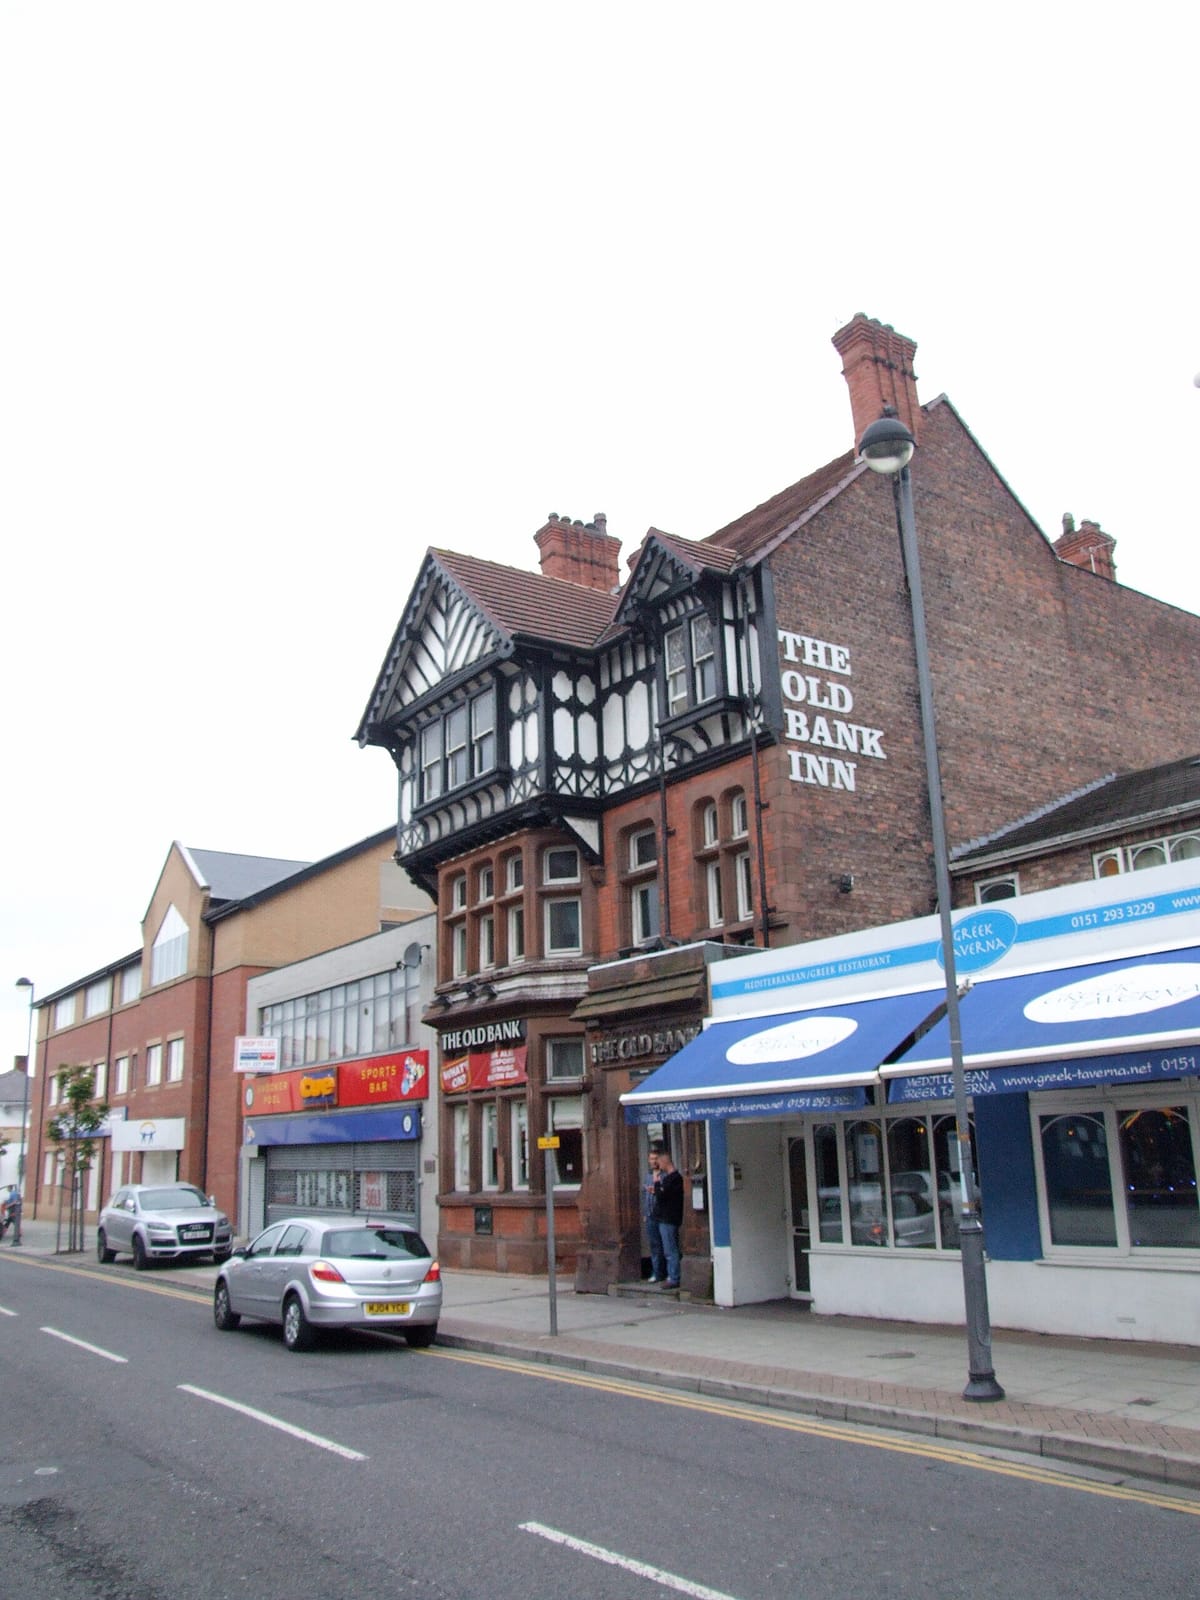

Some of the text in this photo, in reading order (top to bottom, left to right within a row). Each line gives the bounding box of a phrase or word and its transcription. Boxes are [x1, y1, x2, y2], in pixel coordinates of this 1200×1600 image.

[778, 629, 851, 676] THE
[781, 670, 853, 713] OLD
[784, 708, 887, 759] BANK
[787, 750, 857, 792] INN
[1071, 913, 1098, 928] 0151
[1103, 908, 1124, 922] 293
[1126, 902, 1155, 917] 3229
[953, 923, 993, 941] GREEK
[838, 955, 891, 973] RESTAURANT
[442, 1020, 520, 1051] THE OLD BANK
[590, 1040, 618, 1063] THE
[618, 1034, 653, 1059] OLD
[361, 1065, 396, 1080] SPORTS
[1003, 1063, 1152, 1087] www.greek-taverna.net
[1160, 1056, 1196, 1071] 0151
[369, 1081, 387, 1093] BAR
[787, 1099, 810, 1108] 0151
